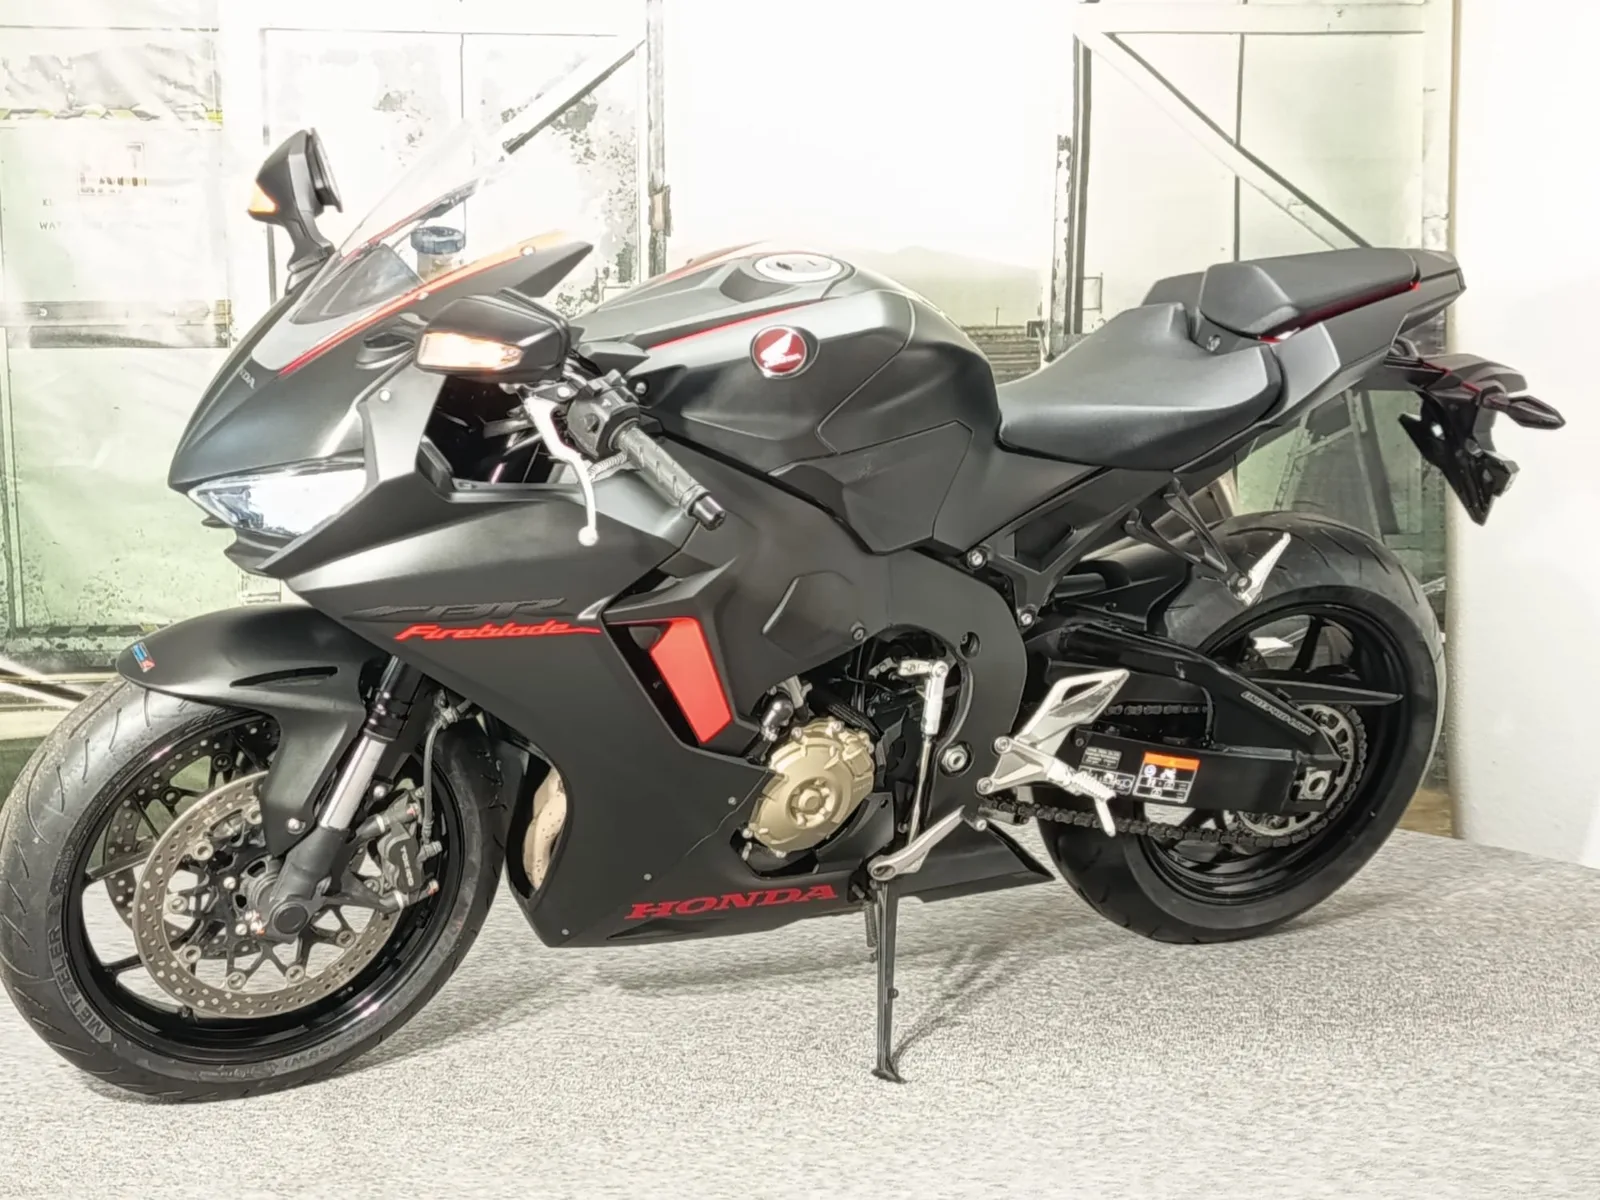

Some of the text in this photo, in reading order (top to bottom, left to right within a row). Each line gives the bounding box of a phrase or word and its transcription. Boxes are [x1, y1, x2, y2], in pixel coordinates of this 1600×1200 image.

[394, 619, 601, 641] Fireblade
[624, 884, 838, 920] HONDA
[47, 924, 107, 1039] METZELER
